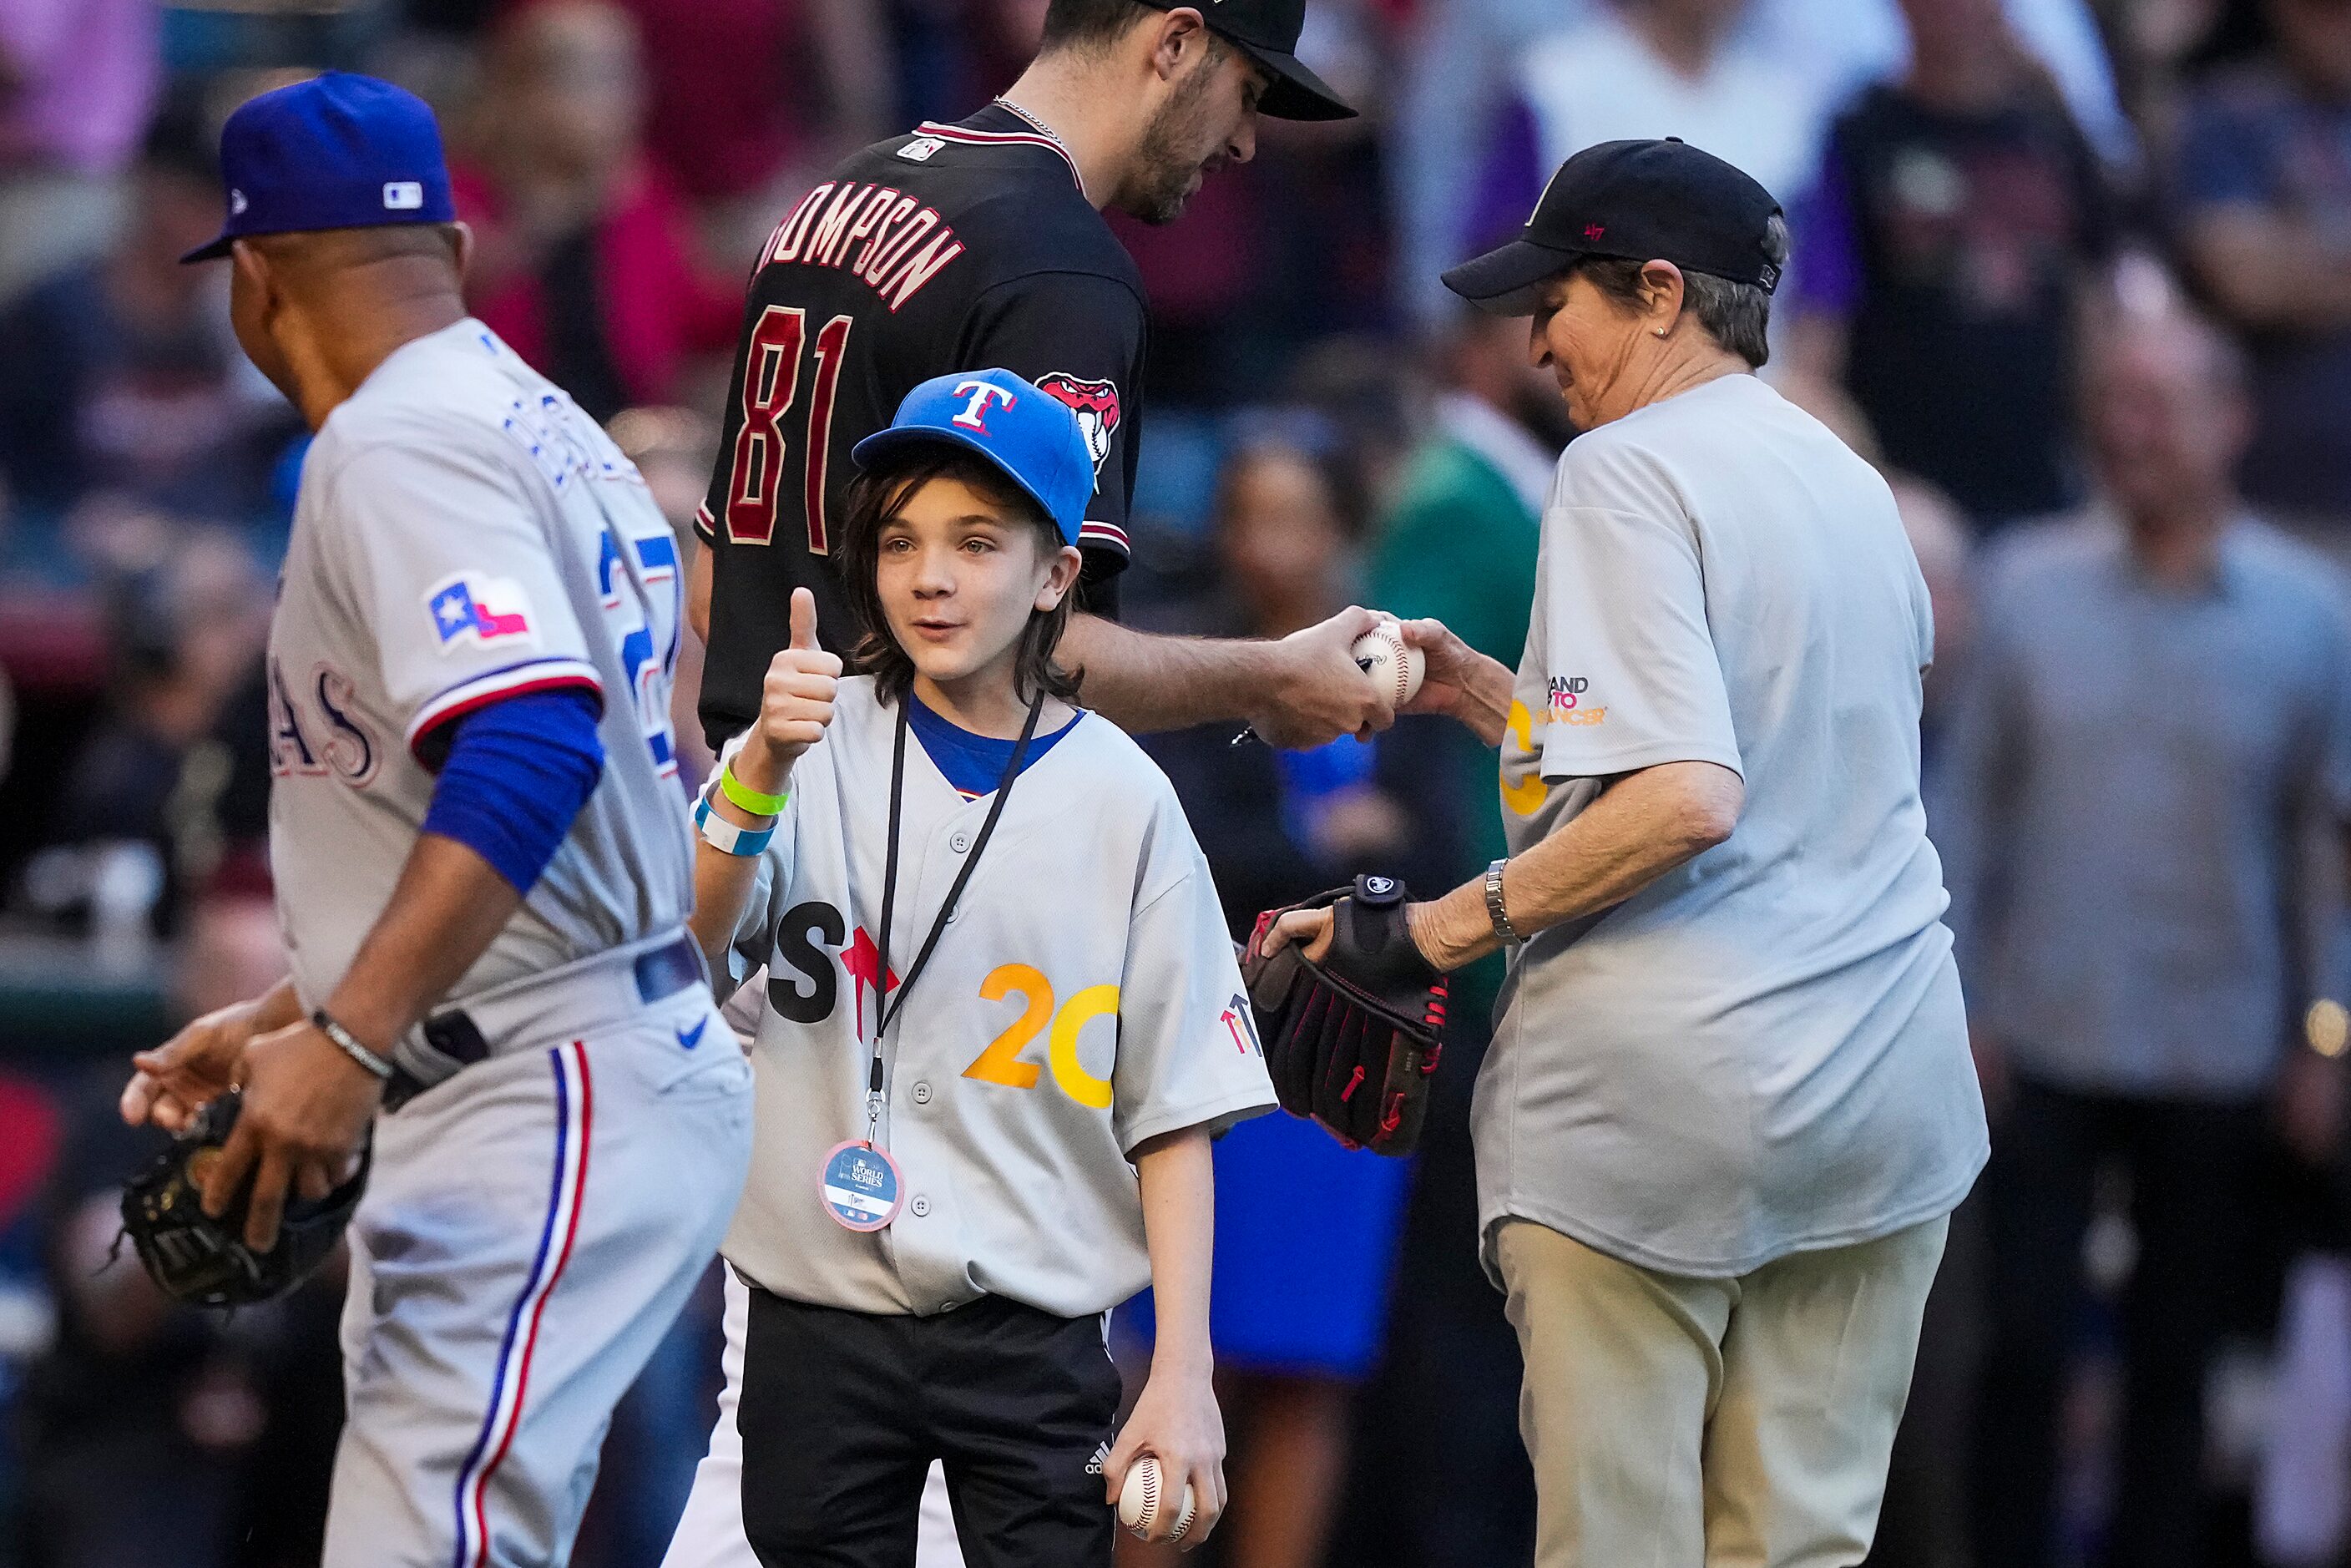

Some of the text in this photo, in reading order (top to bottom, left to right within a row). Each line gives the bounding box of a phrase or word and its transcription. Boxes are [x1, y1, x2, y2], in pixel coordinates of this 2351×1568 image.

[952, 381, 1018, 438] T
[726, 304, 853, 556] 81
[1548, 675, 1589, 694] AND
[1553, 690, 1577, 709] TO
[851, 1172, 882, 1188] SERIES
[852, 1164, 884, 1180] WORLD
